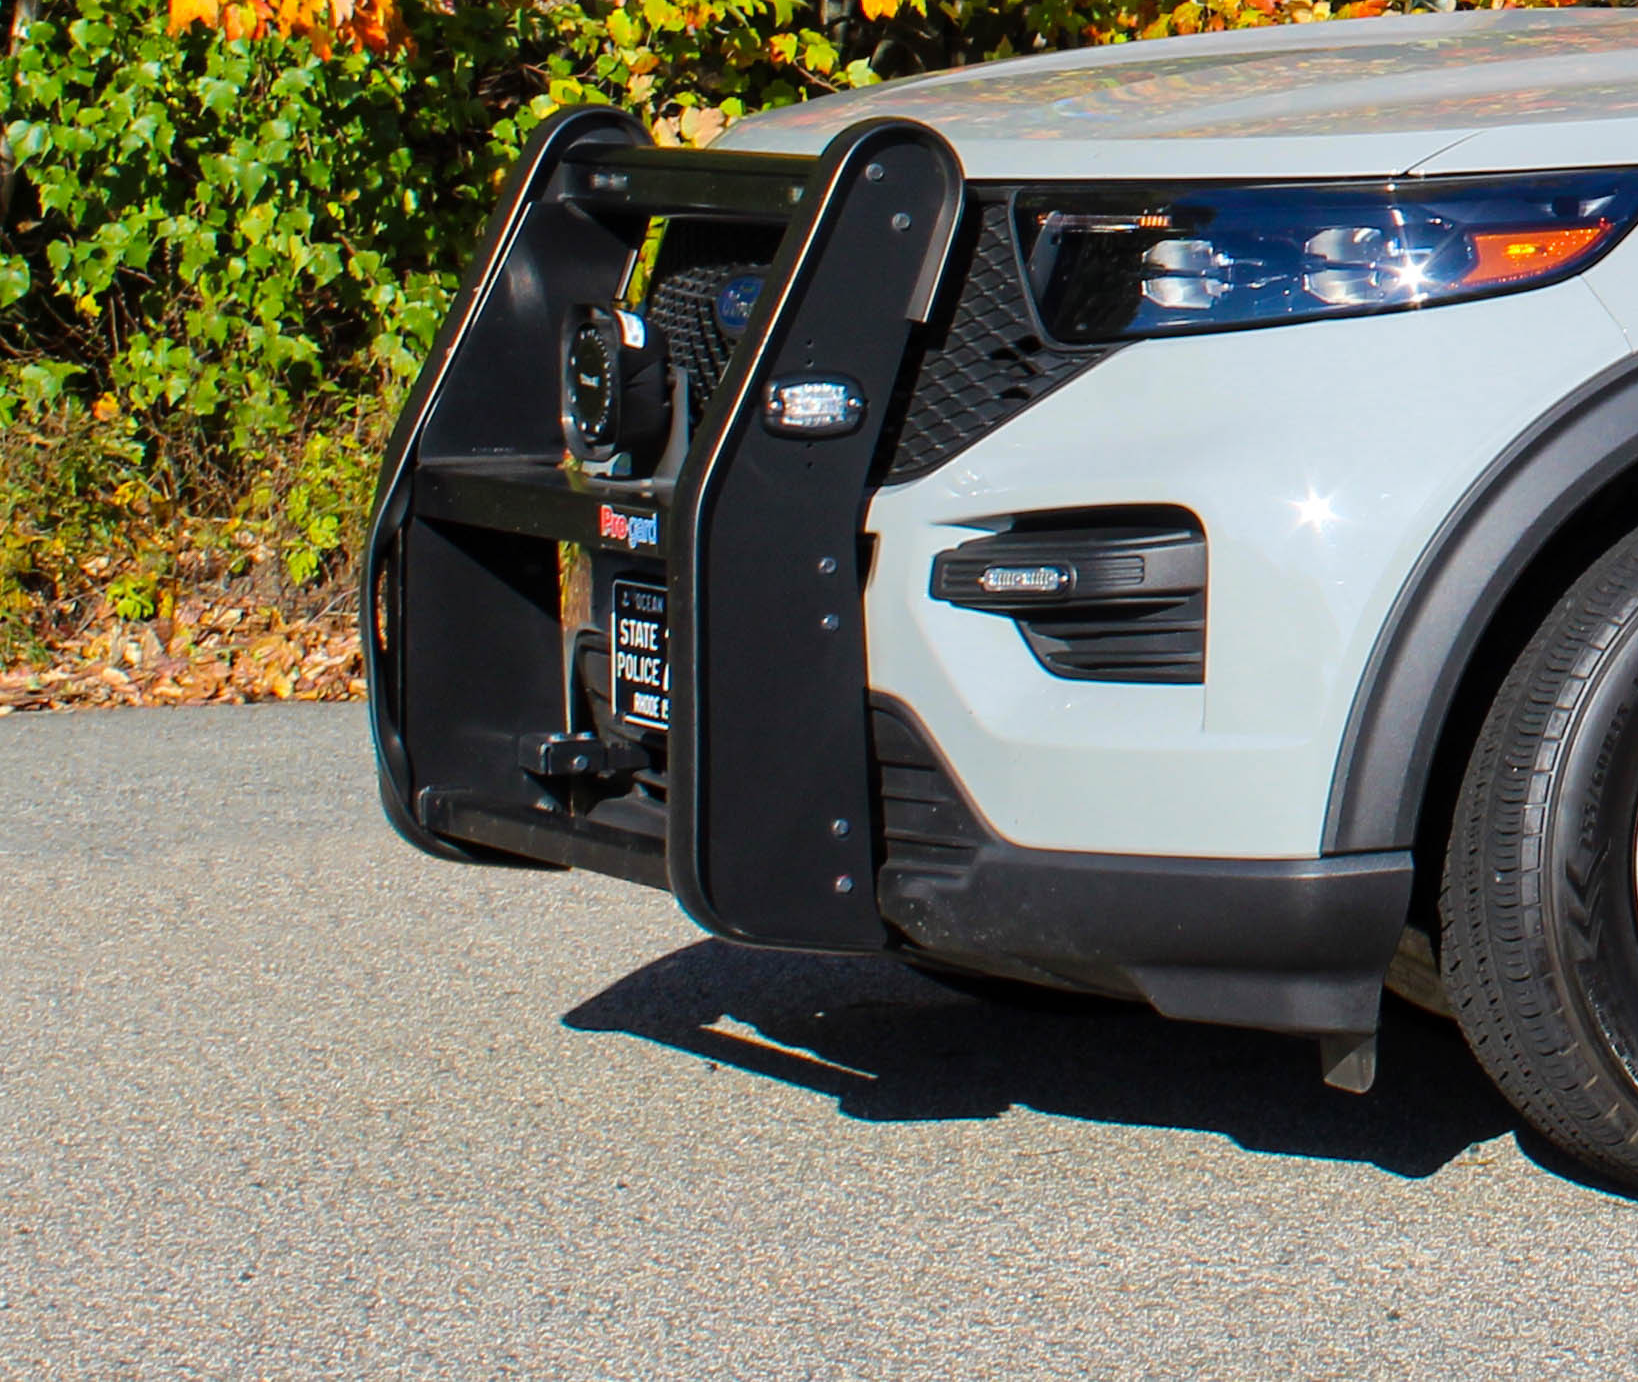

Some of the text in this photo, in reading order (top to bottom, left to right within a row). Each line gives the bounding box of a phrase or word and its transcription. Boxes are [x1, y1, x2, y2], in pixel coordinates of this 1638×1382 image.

[619, 618, 659, 652] STATE
[616, 651, 662, 687] POLICE
[633, 691, 660, 718] RHODE
